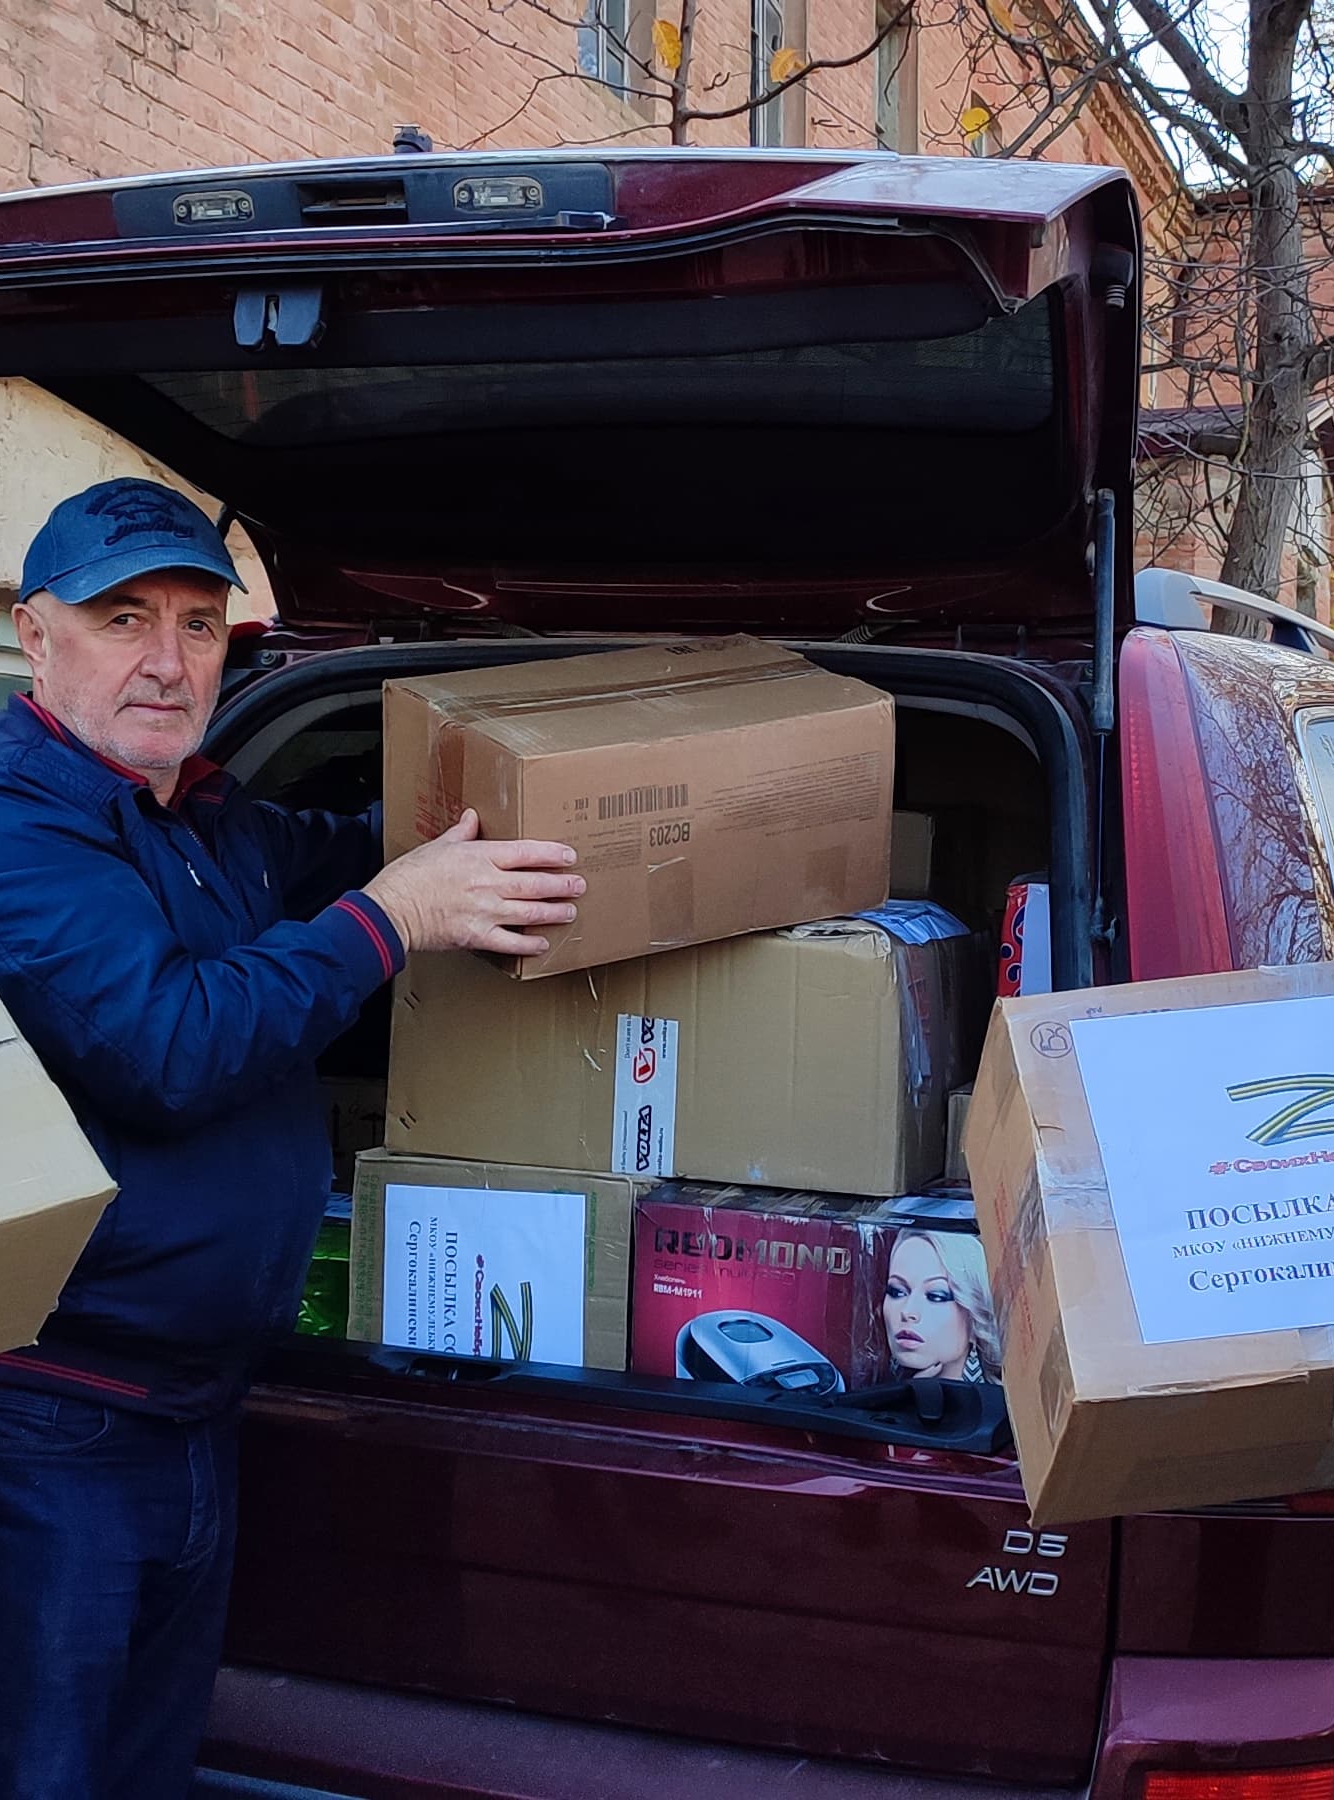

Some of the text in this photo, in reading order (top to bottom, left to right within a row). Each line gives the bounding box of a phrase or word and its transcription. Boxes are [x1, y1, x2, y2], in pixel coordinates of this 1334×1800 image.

[648, 821, 691, 848] BC203
[636, 1104, 652, 1171] VOLTA
[428, 1216, 438, 1250] МКОУ
[654, 1228, 852, 1275] REDMOND
[1171, 1239, 1227, 1260] МКОУ
[443, 1232, 458, 1329] ПОСЫЛКА
[1003, 1530, 1069, 1557] D5
[965, 1566, 1059, 1596] AWD
